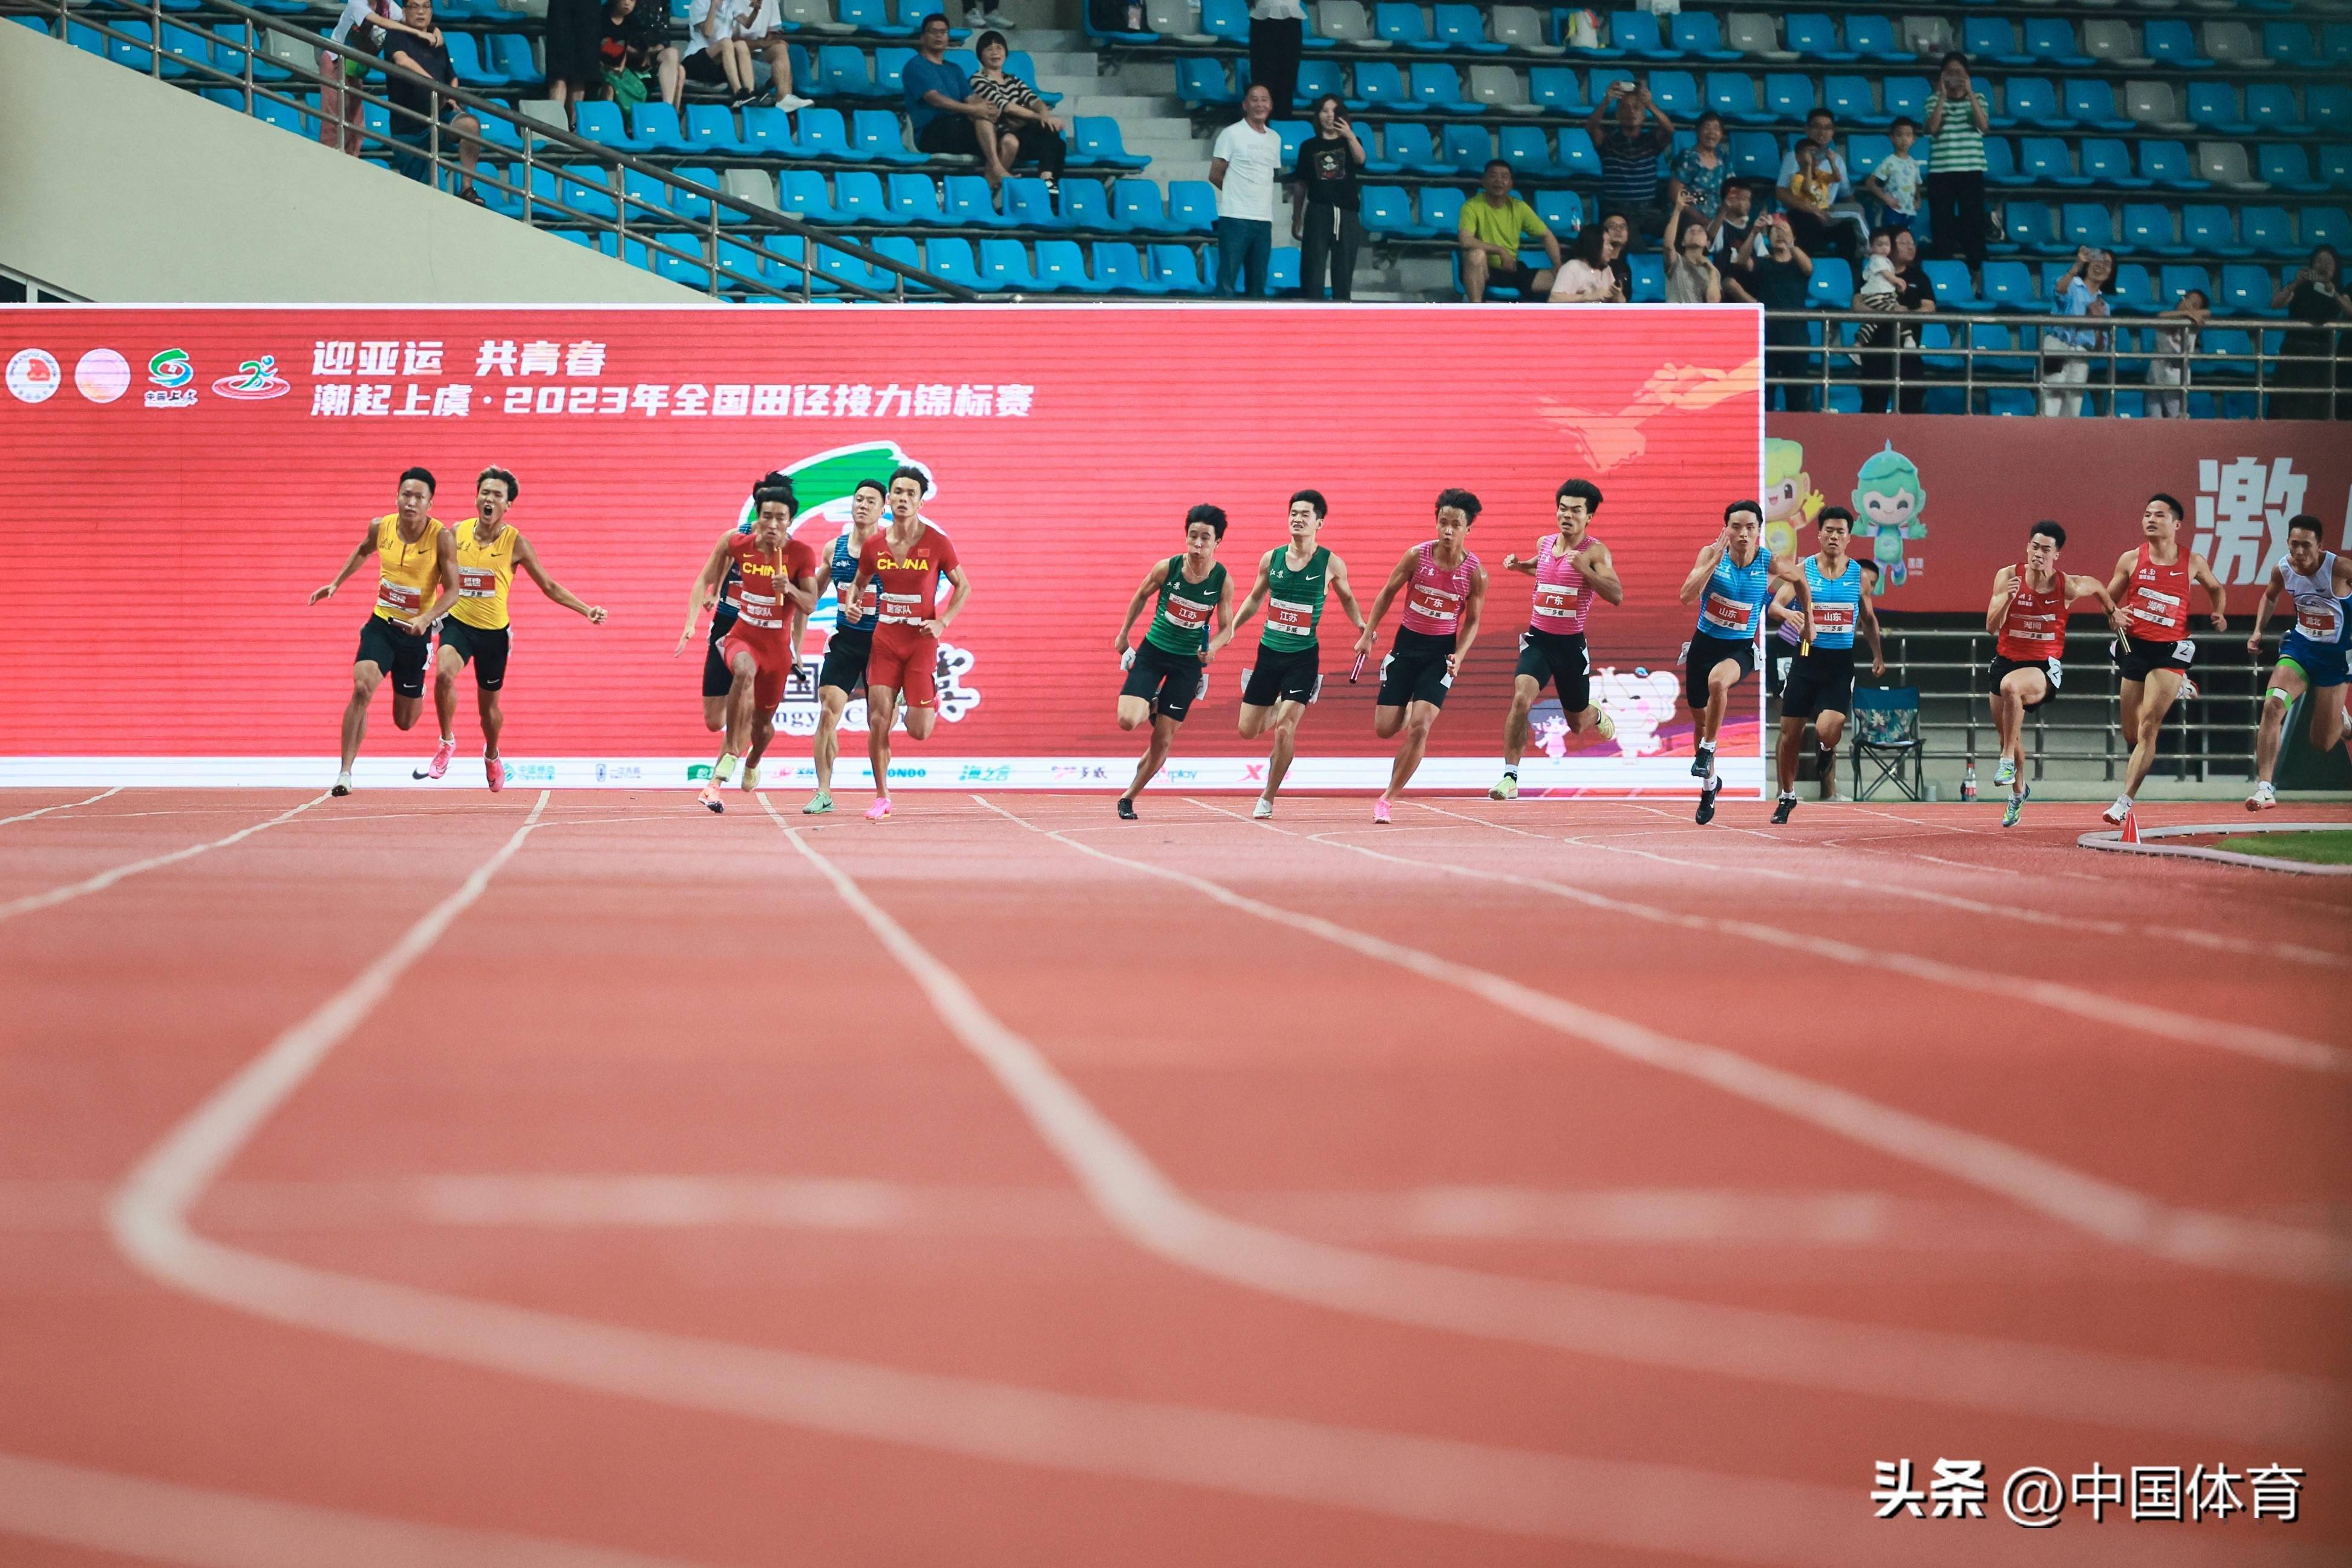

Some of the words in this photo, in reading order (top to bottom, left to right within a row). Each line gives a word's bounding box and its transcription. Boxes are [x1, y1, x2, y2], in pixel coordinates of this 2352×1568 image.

[312, 341, 444, 376] 迎亚运
[475, 341, 606, 376] 共青春
[1424, 596, 1444, 608] 广东
[1545, 595, 1564, 606] 广东
[2147, 599, 2166, 613] 湖南
[1178, 607, 1197, 619] 江苏
[1279, 610, 1298, 622] 江苏
[1719, 607, 1738, 619] 山东
[1824, 612, 1842, 622] 山东
[2179, 641, 2190, 656] 2
[887, 768, 926, 777] ONDO
